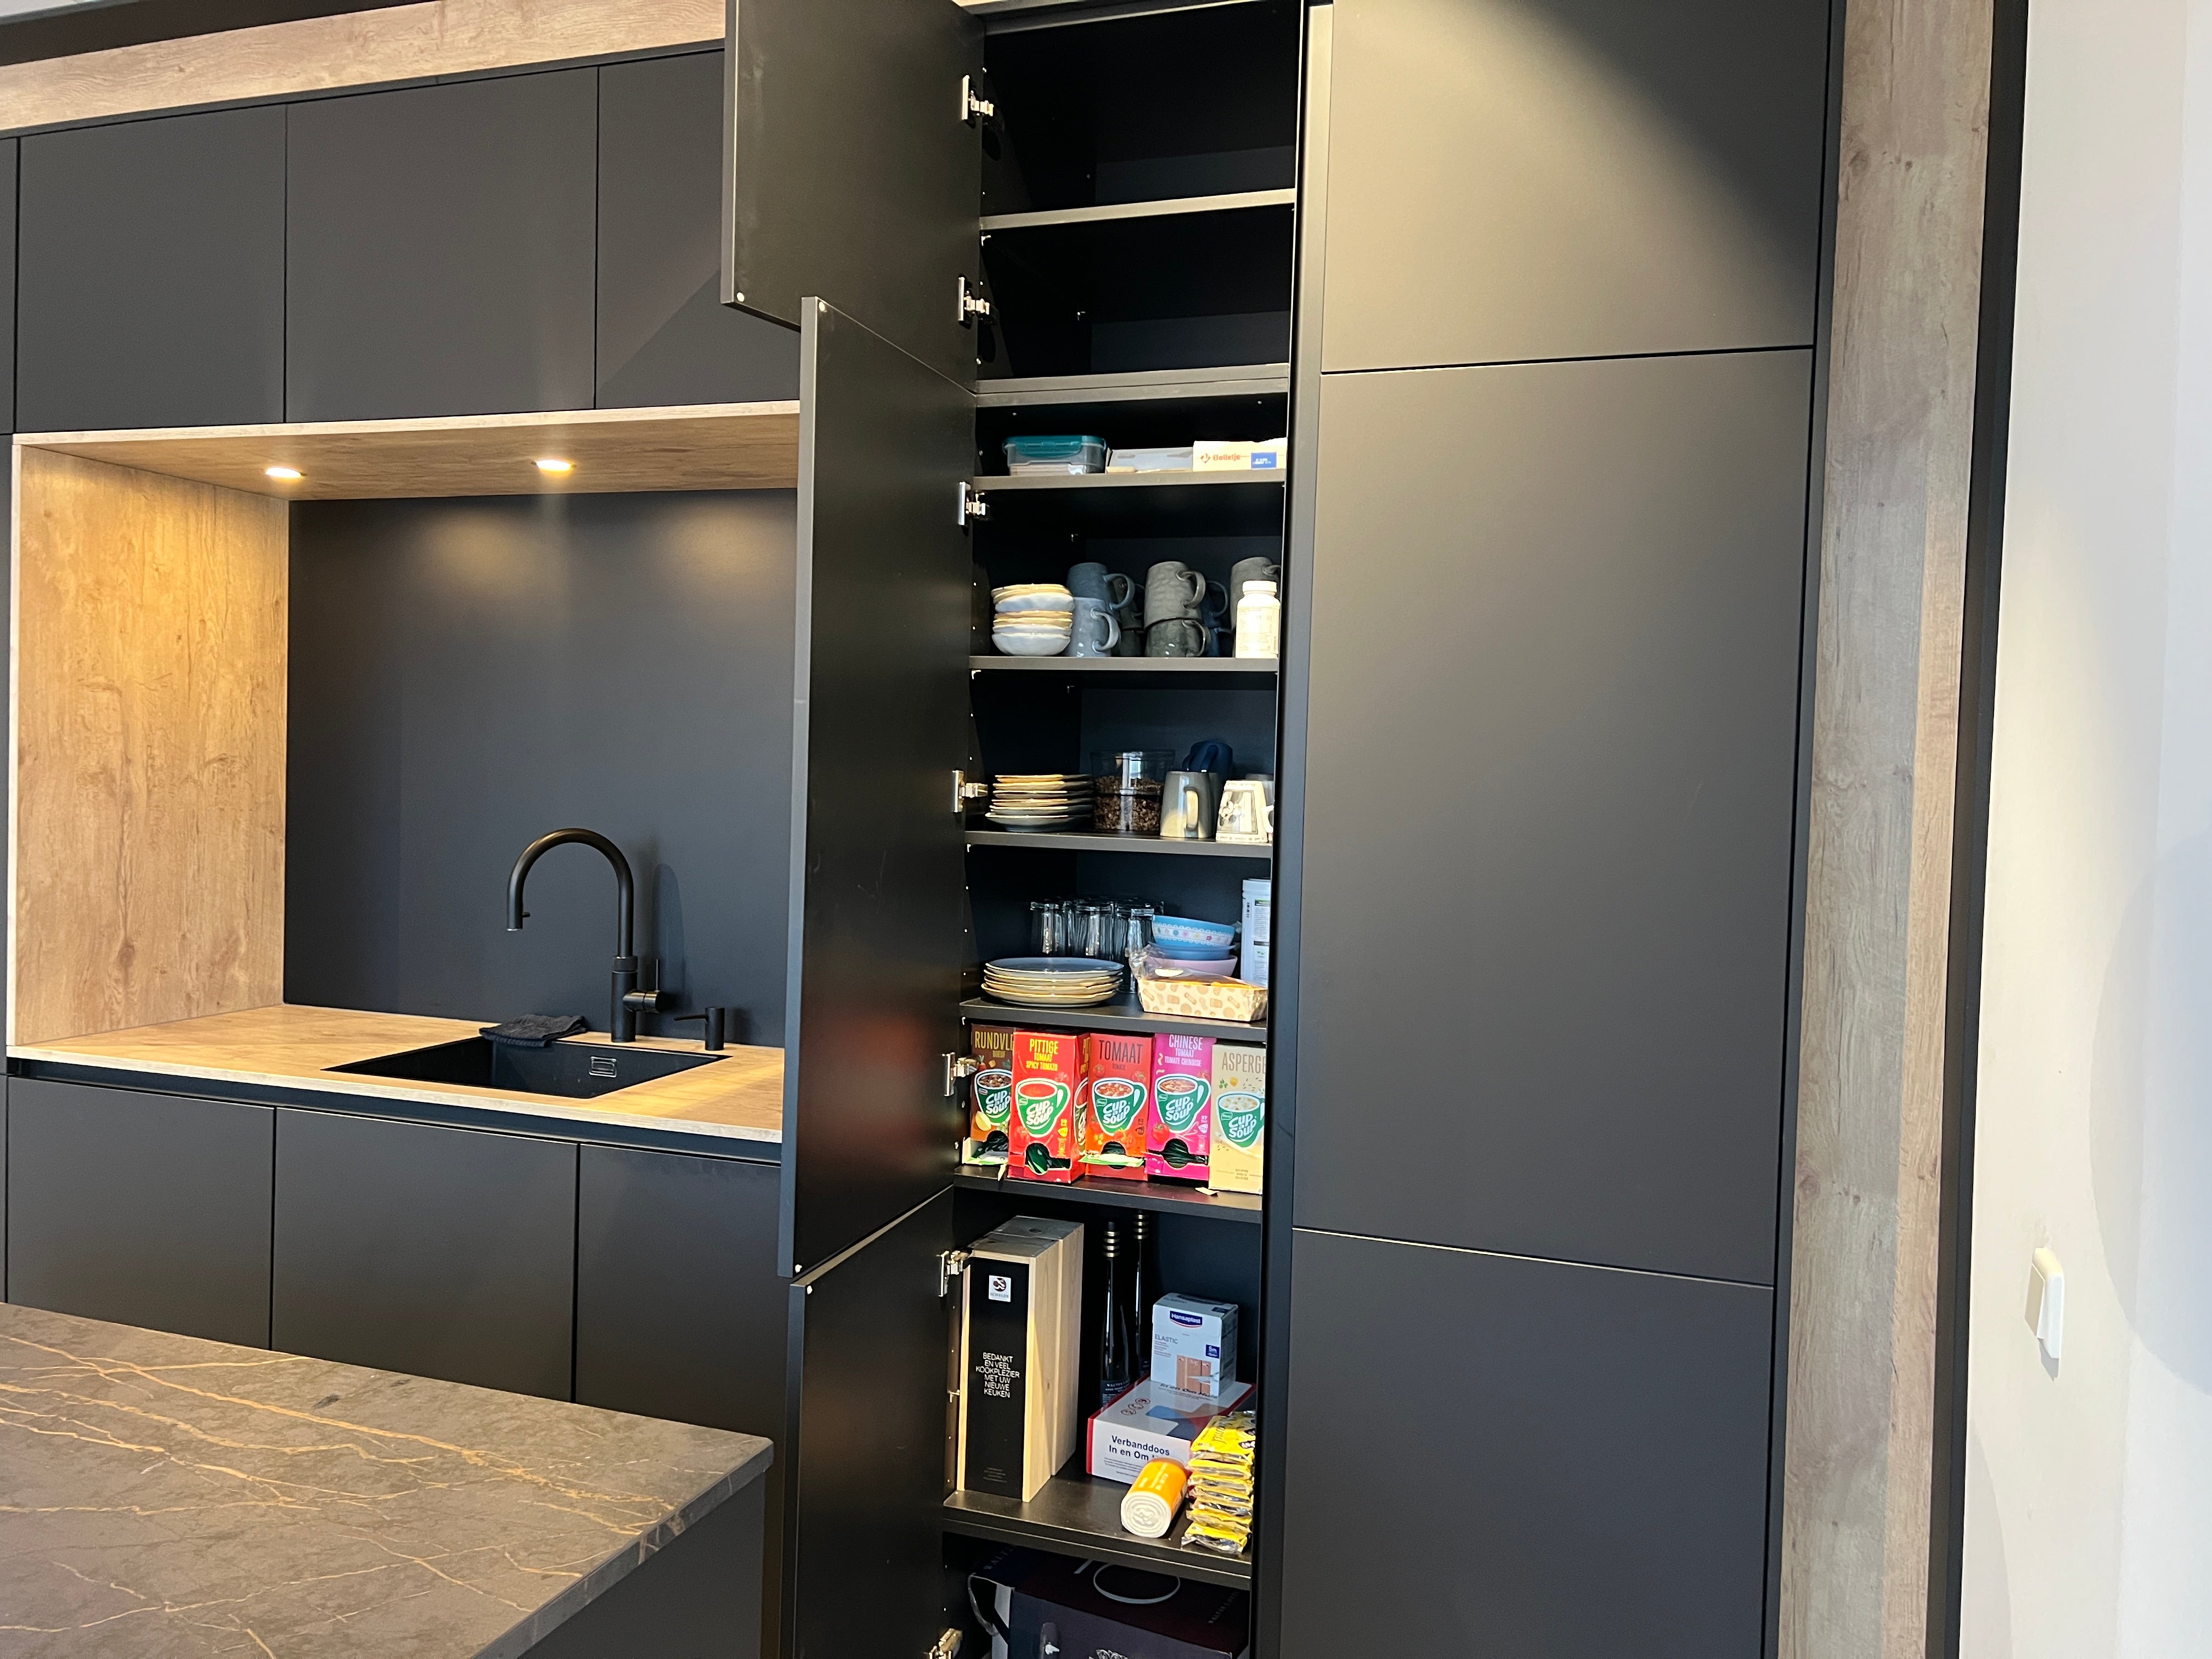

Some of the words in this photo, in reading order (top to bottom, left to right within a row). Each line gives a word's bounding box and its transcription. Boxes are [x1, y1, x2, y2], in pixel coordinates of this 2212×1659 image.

[1029, 1039, 1059, 1054] PITTIGE
[1169, 1034, 1203, 1051] CHINESE
[1034, 1052, 1053, 1062] TOMAAT
[1099, 1040, 1143, 1064] TOMAAT
[1175, 1048, 1194, 1058] TOMAAT
[1026, 1060, 1039, 1070] SPICY
[1040, 1062, 1058, 1071] TOMATO
[1171, 1313, 1201, 1324] Hansaplast
[1154, 1334, 1178, 1344] ELASTIC
[983, 1352, 1013, 1363] BEDANKT
[994, 1361, 1011, 1370] VEEL
[975, 1365, 1020, 1378] KOOKPLEZIER
[984, 1381, 1010, 1391] NIEUWE
[984, 1387, 1011, 1398] KEUKEN
[1111, 1435, 1170, 1455] Verbanddoos
[1109, 1444, 1117, 1454] In
[1134, 1451, 1149, 1461] Om
